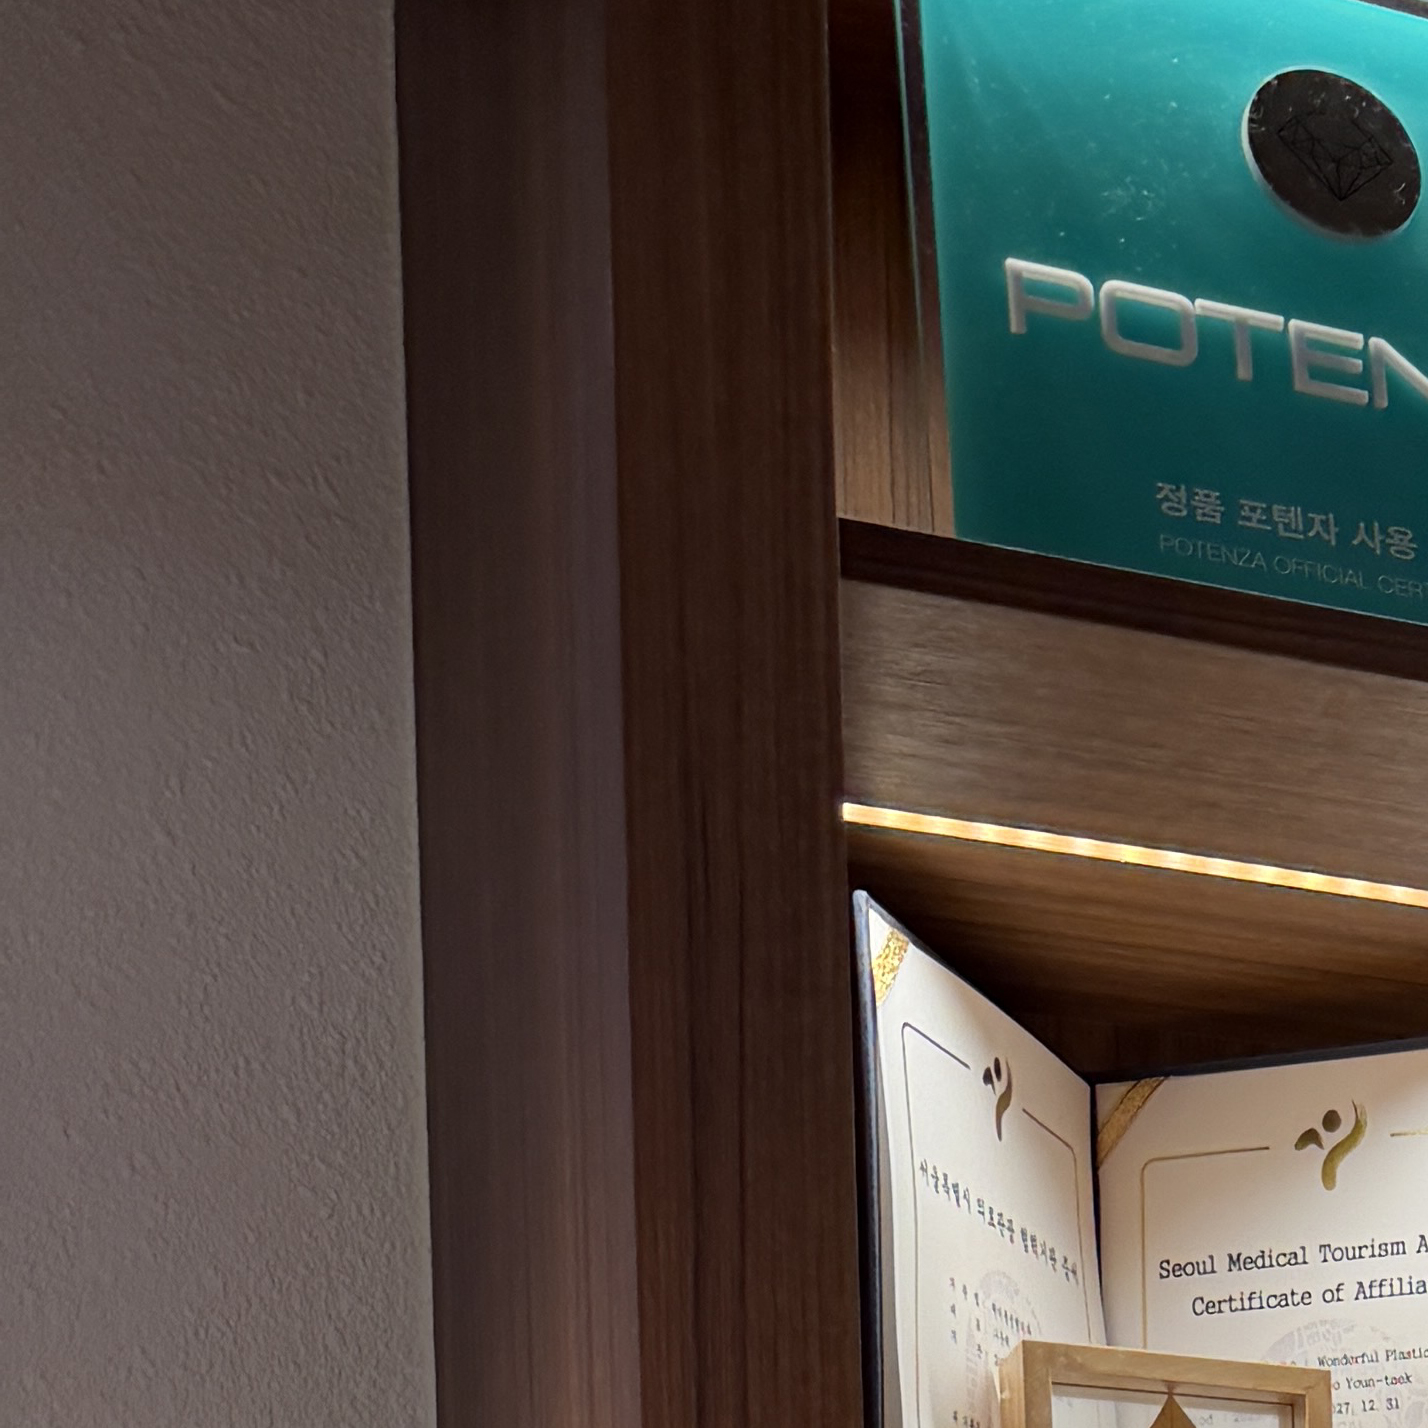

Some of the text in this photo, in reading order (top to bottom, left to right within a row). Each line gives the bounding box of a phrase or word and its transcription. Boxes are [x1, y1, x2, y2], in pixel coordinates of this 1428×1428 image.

[1156, 482, 1225, 524] 정품
[1238, 498, 1339, 546] 포텐자
[1351, 520, 1417, 560] 사용
[1159, 534, 1267, 572] POTENZA
[1274, 556, 1367, 591] OFFICIAL
[1158, 1254, 1215, 1281] Seoul
[1227, 1245, 1309, 1272] Medical
[1319, 1236, 1407, 1263] Tourism
[1191, 1287, 1312, 1318] Certificate
[1322, 1283, 1345, 1305] of
[1317, 1350, 1380, 1368] Wonderful
